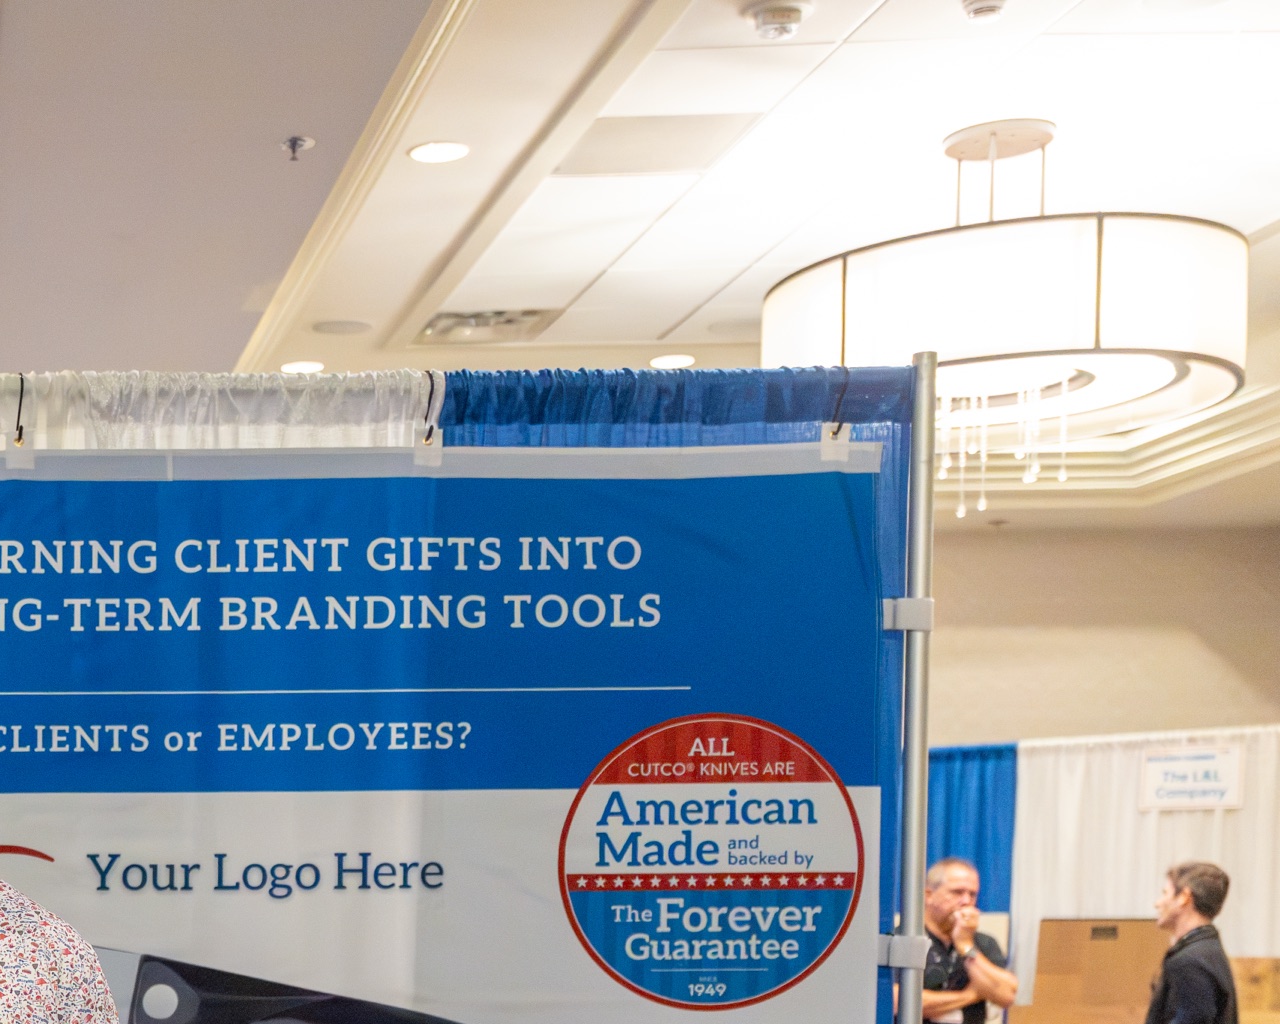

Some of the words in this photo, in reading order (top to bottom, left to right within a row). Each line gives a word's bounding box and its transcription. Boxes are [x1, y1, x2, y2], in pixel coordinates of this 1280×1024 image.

[174, 537, 349, 573] CLIENT
[365, 536, 502, 571] GIFTS
[517, 535, 643, 570] INTO
[219, 595, 488, 631] BRANDING
[503, 593, 661, 629] TOOLS
[164, 730, 202, 752] or
[217, 721, 472, 752] EMPLOYEES?
[688, 738, 735, 756] ALL
[700, 762, 758, 776] KNIVES
[762, 761, 795, 775] ARE
[596, 789, 818, 826] American
[595, 830, 720, 867] Made
[728, 835, 759, 849] and
[86, 854, 200, 891] Your
[214, 853, 321, 898] Logo
[332, 852, 444, 889] Here
[728, 851, 787, 865] backed
[794, 851, 814, 869] by
[611, 904, 653, 923] The
[656, 898, 822, 933] Forever
[625, 934, 799, 961] Guarantee
[688, 983, 727, 997] 1949
